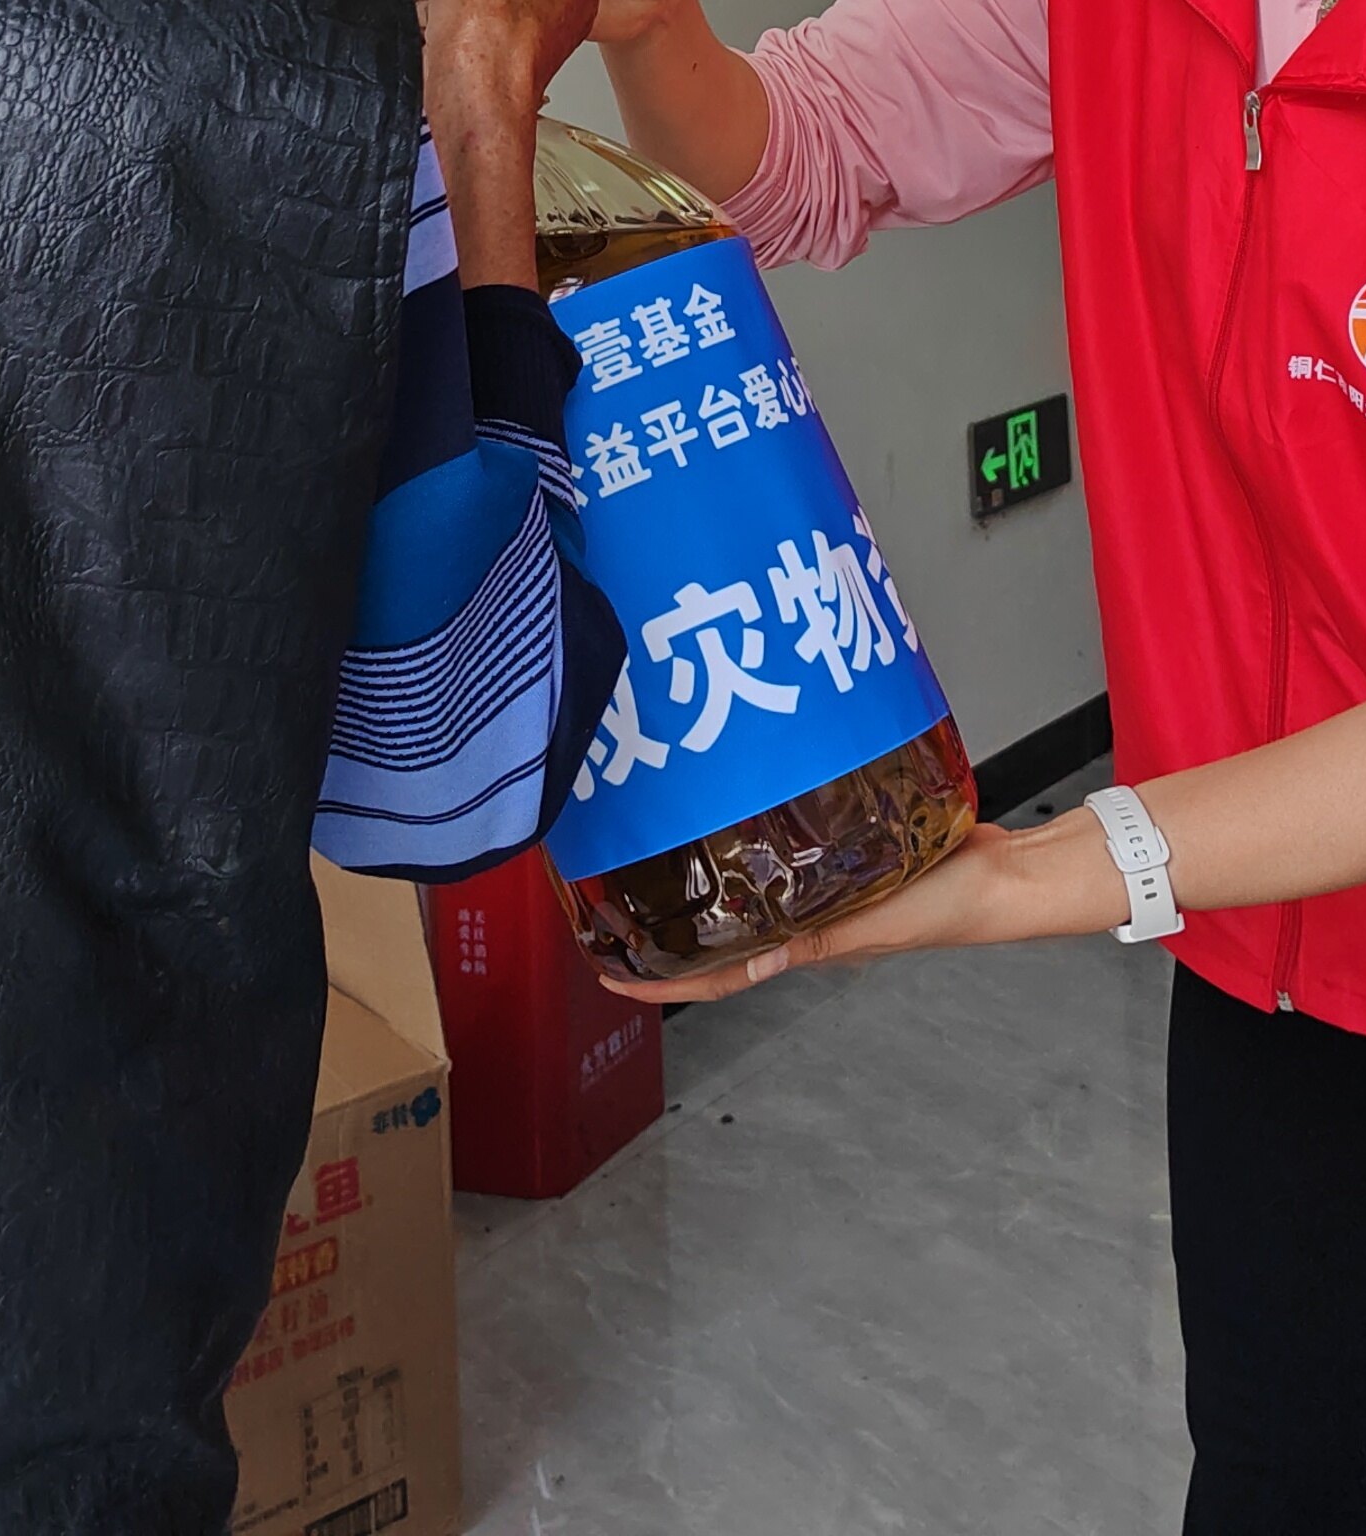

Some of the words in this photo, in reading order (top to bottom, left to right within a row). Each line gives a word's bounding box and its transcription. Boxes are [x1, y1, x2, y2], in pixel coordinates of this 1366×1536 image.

[573, 282, 737, 394] 壹基金
[571, 356, 817, 508] 益平台爱心
